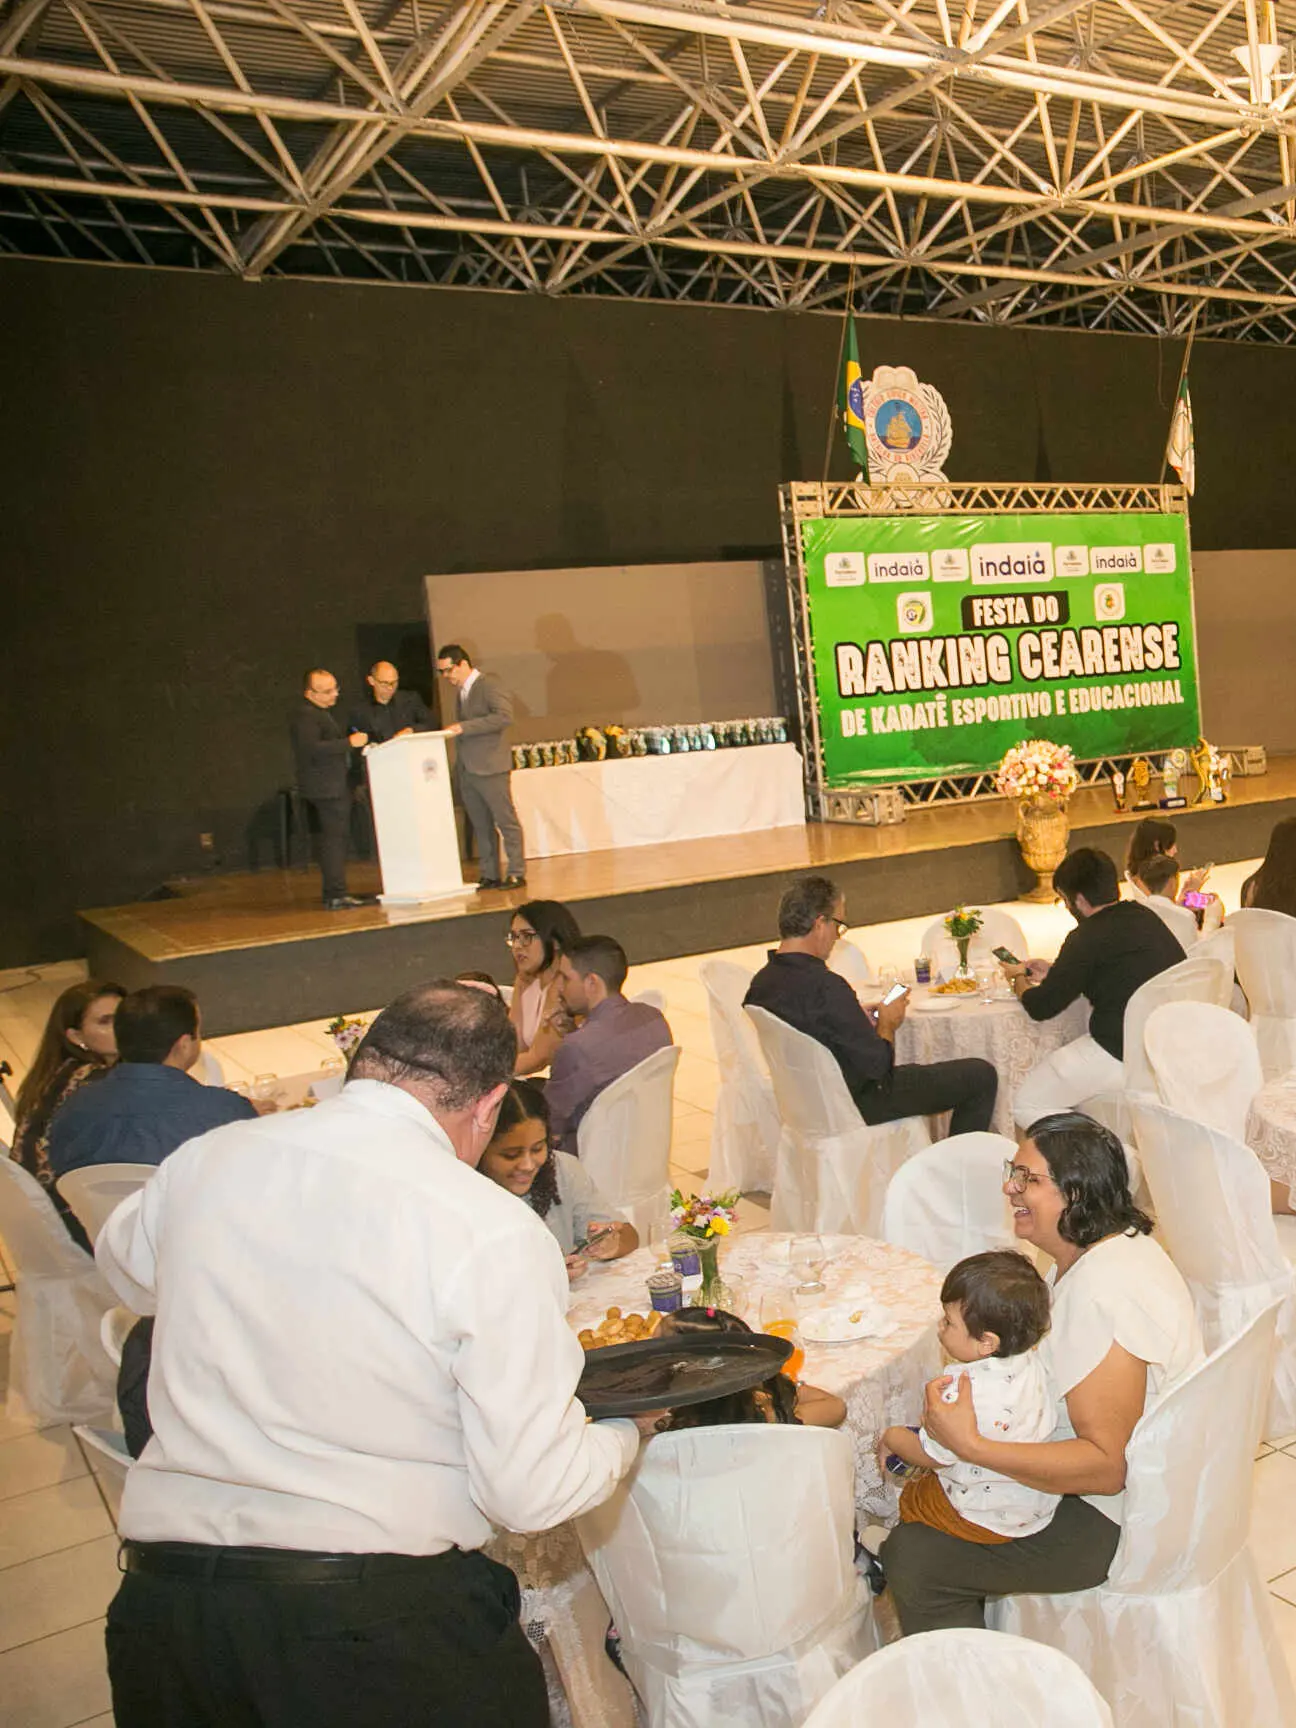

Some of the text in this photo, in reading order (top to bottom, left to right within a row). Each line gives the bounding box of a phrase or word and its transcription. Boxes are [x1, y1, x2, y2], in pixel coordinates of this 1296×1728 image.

[972, 595, 1060, 626] FESTA DO
[835, 622, 1181, 696] RANKING CEARENSE
[840, 679, 1185, 738] DE KARATÊ ESPORTIVO E EDUCACIONAL
